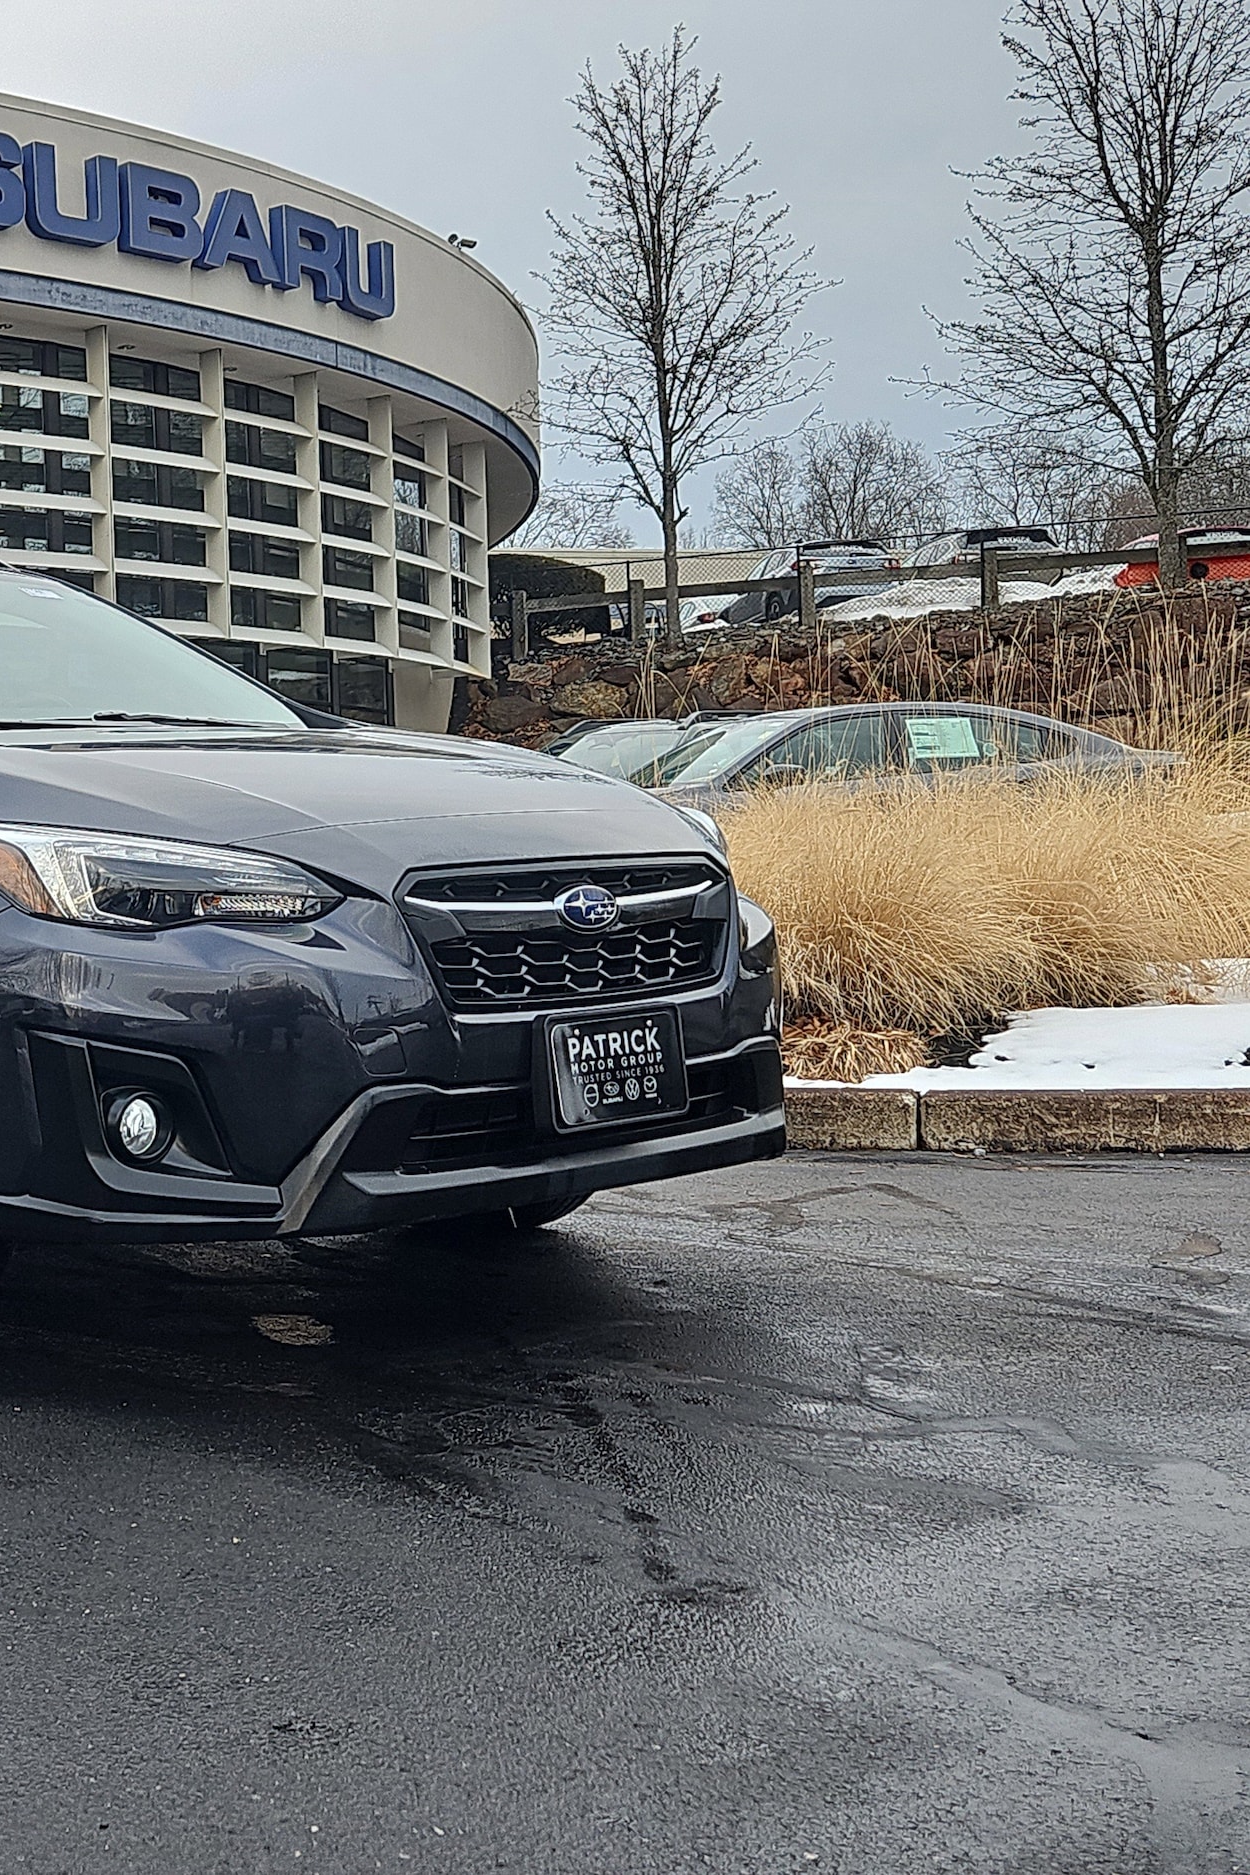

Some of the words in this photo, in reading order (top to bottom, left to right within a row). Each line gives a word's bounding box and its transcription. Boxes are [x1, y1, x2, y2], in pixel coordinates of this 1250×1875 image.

[567, 1026, 661, 1062] PATRICK
[570, 1058, 615, 1075] MOTOR
[620, 1051, 663, 1067] GROUP
[572, 1071, 612, 1086] TRUSTED
[615, 1067, 642, 1079] SINCE
[645, 1064, 665, 1074] 1936
